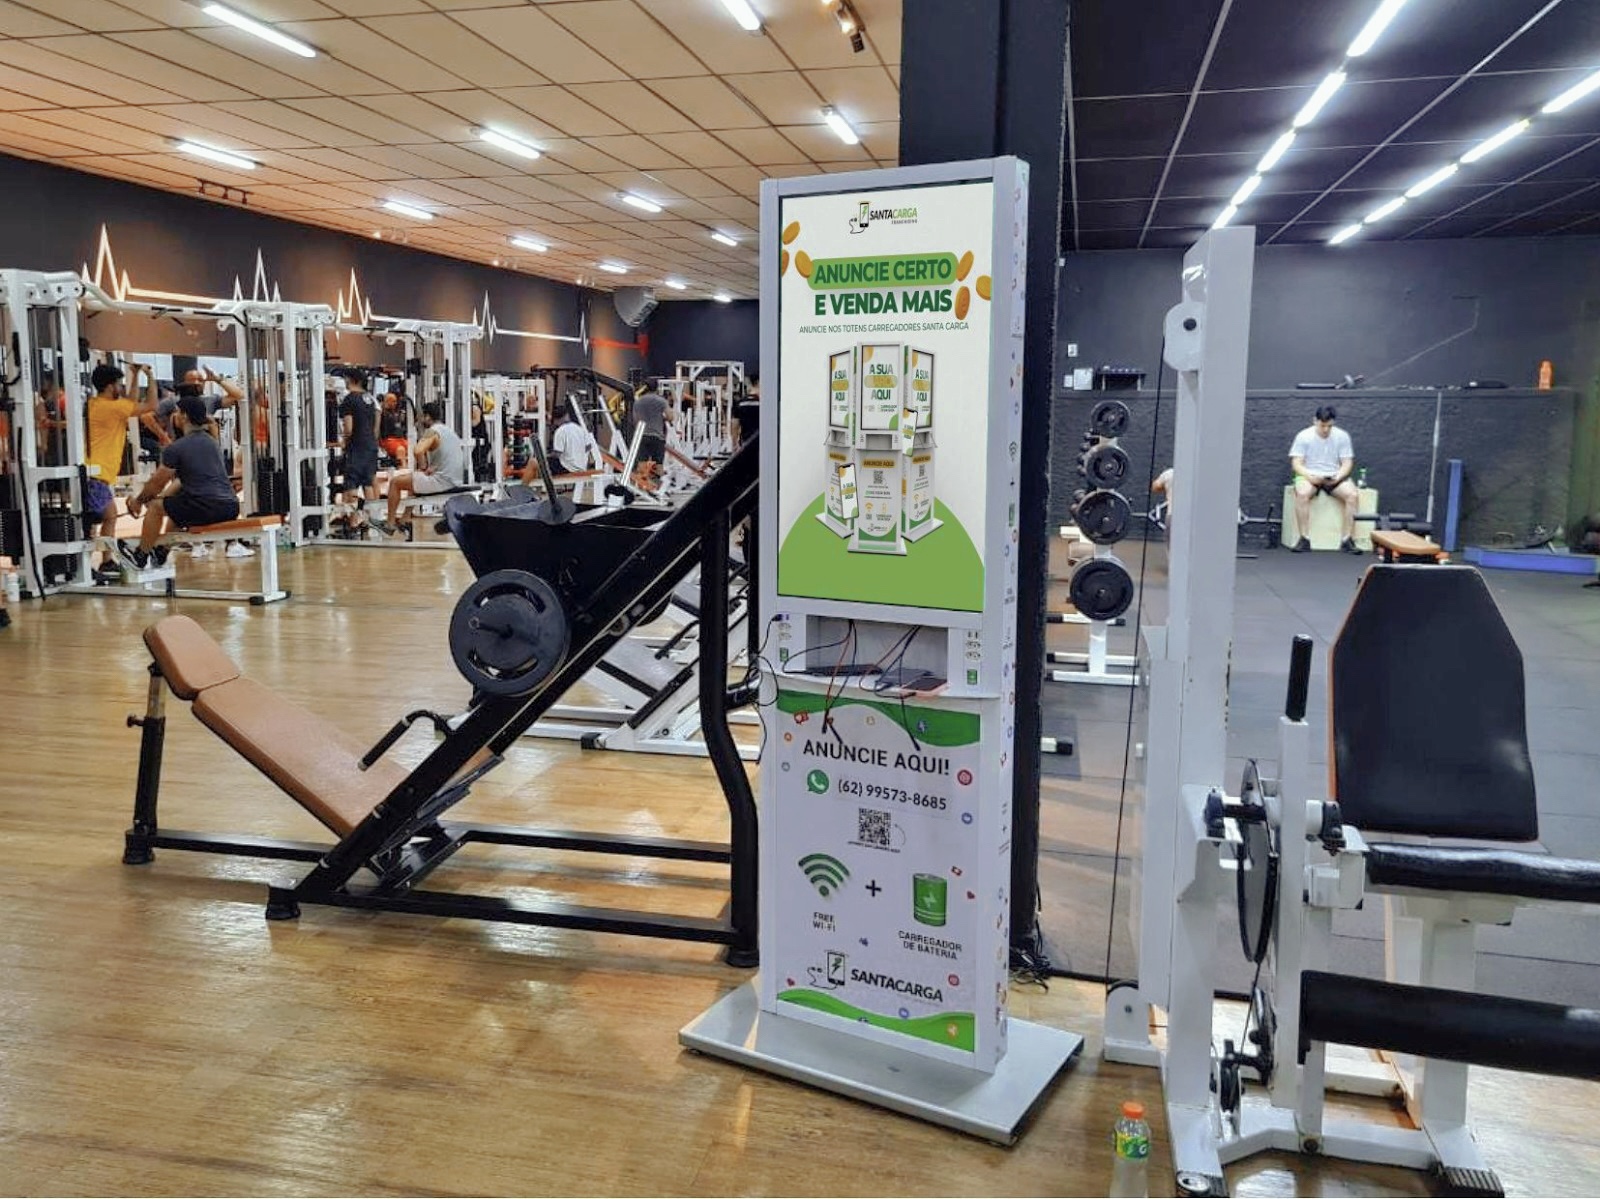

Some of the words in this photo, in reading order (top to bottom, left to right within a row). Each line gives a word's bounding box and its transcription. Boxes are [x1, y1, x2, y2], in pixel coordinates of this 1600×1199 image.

[870, 208, 918, 220] SANTACARGA
[814, 261, 889, 284] ANUNCIE
[893, 258, 952, 281] CERTO
[815, 294, 826, 315] E
[830, 291, 898, 315] VENDA
[902, 289, 952, 313] MAIS
[799, 325, 827, 333] ANUNCIE
[829, 324, 842, 333] NOS
[843, 324, 867, 332] TOTENS
[868, 323, 921, 332] CARREGADORES
[922, 322, 944, 331] SANTA
[945, 322, 969, 330] CARGA
[876, 364, 894, 374] SUA
[871, 389, 891, 400] AQUI
[803, 739, 887, 767] ANUNCIE
[894, 754, 949, 776] AQUI!
[838, 778, 863, 796] (62)
[867, 784, 947, 810] 99573-8685
[813, 912, 834, 922] FREE
[813, 920, 836, 932] WI-FI
[899, 930, 963, 952] CARREGADOR
[903, 940, 914, 950] DE
[917, 942, 958, 960] BATERIA
[851, 968, 944, 1002] SANTACARGA
